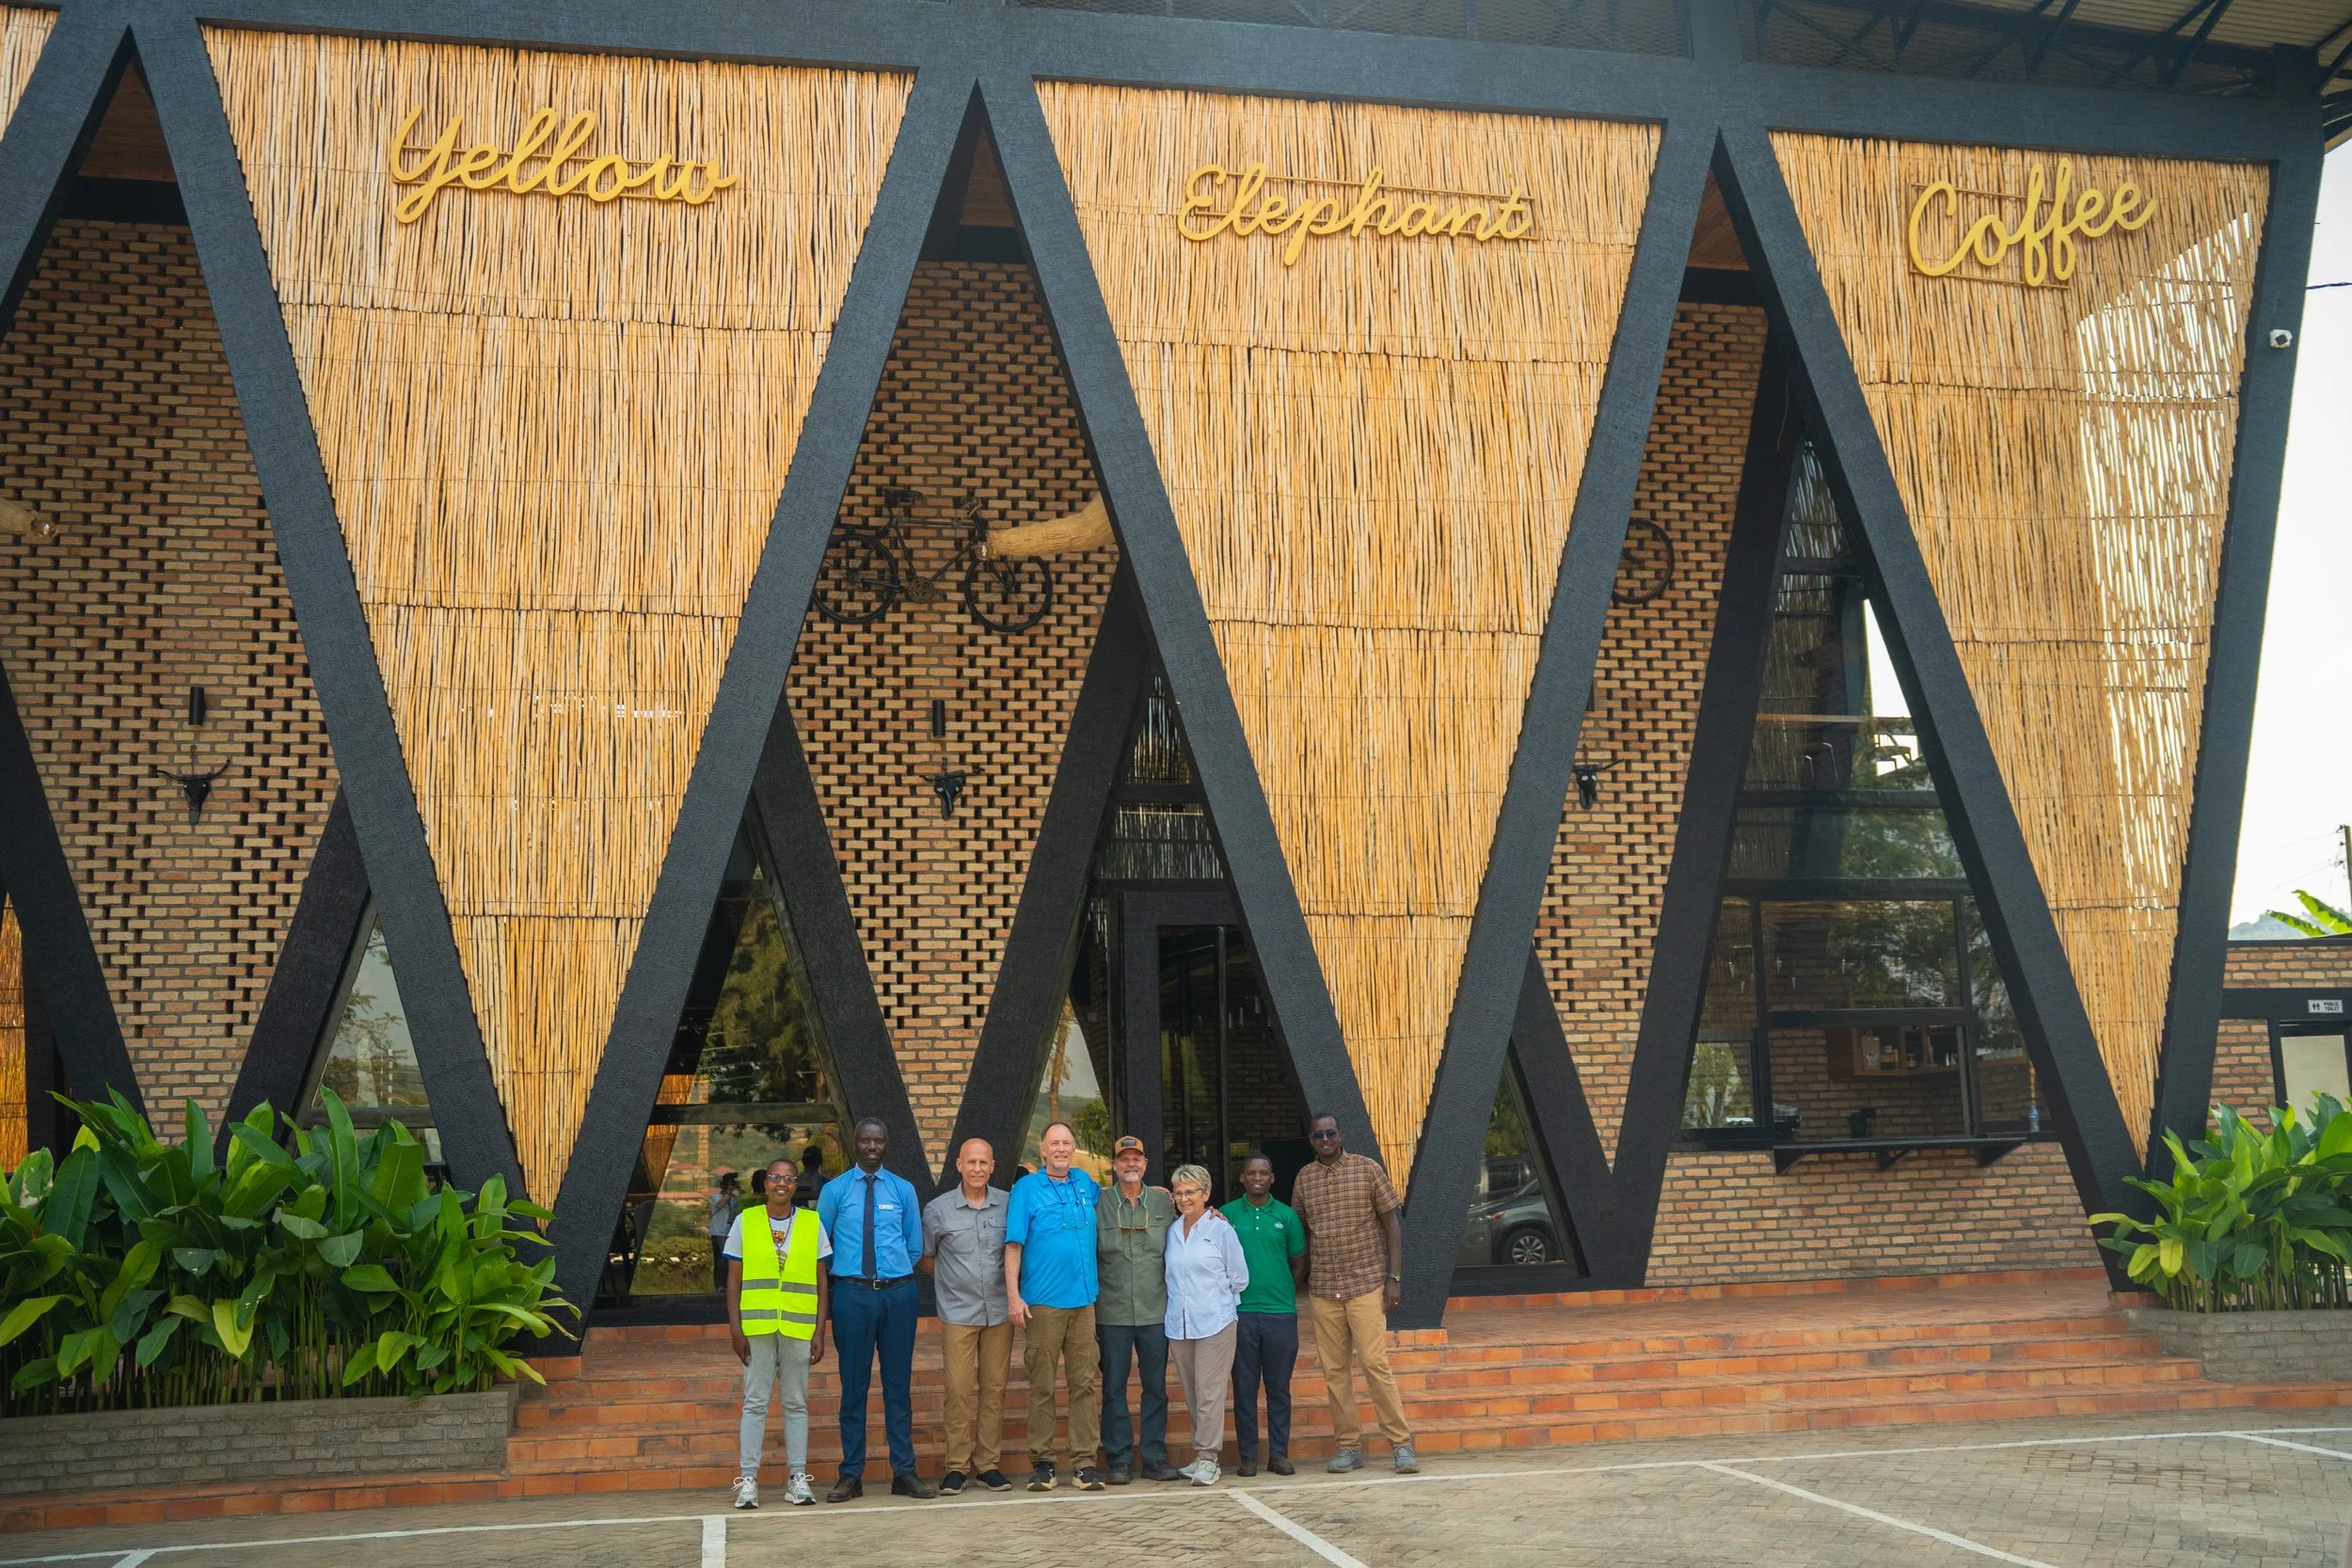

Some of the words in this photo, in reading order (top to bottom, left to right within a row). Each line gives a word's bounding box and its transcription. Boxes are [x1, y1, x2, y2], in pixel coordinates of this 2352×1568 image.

[390, 105, 737, 224] Yellow
[1178, 162, 1533, 266] Elephant
[1909, 157, 2158, 287] Coffee
